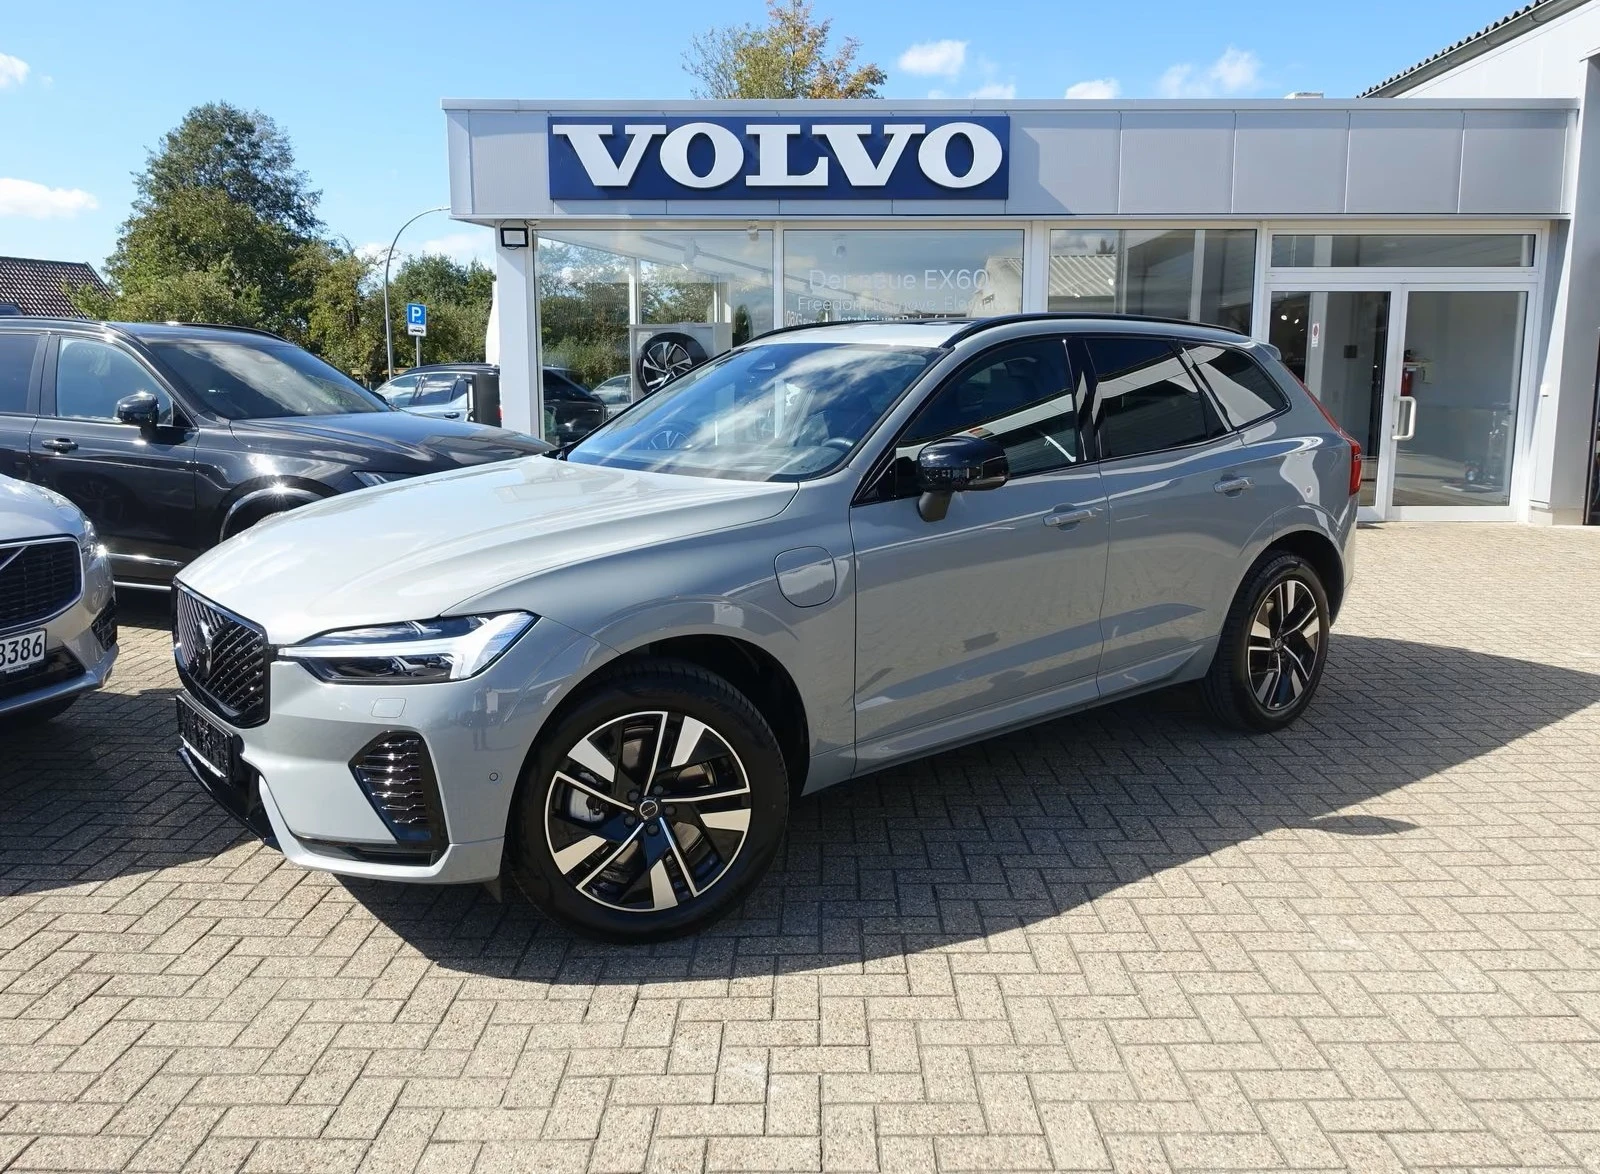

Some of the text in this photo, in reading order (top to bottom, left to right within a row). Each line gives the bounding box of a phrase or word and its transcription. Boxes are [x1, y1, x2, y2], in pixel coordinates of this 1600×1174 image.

[552, 122, 1002, 188] VOLVO
[925, 268, 989, 290] EX60
[411, 306, 422, 322] P
